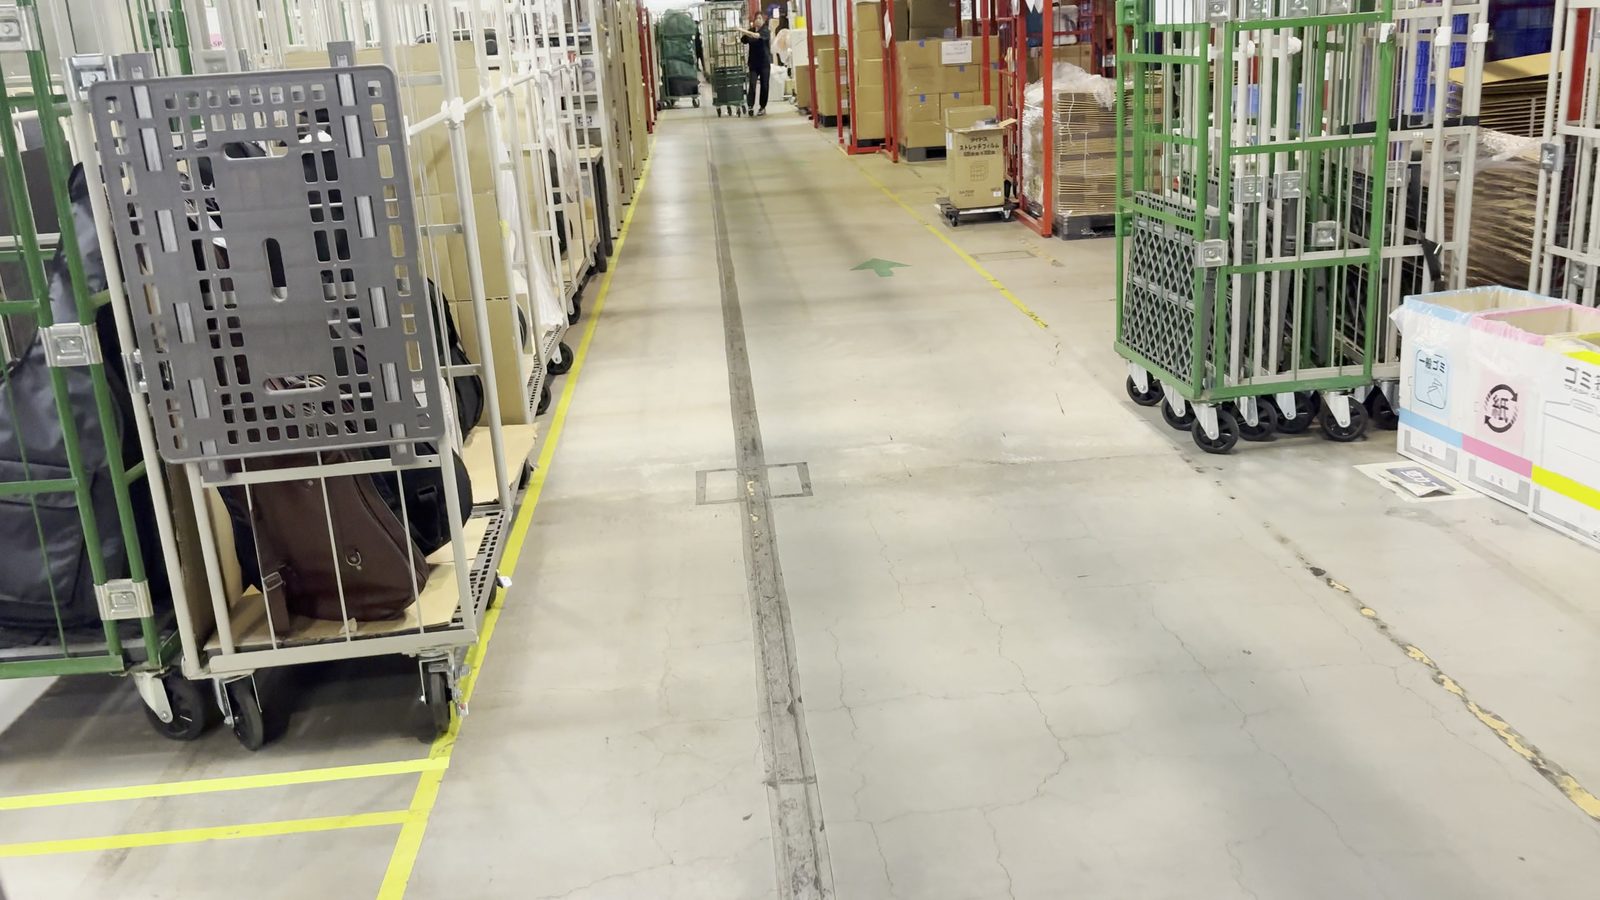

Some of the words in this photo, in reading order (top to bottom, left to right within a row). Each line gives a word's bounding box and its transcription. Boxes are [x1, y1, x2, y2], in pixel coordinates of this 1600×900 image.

[1418, 357, 1446, 373] 一般ゴミ
[1563, 366, 1600, 391] ゴミ
[1491, 394, 1509, 423] 紙
